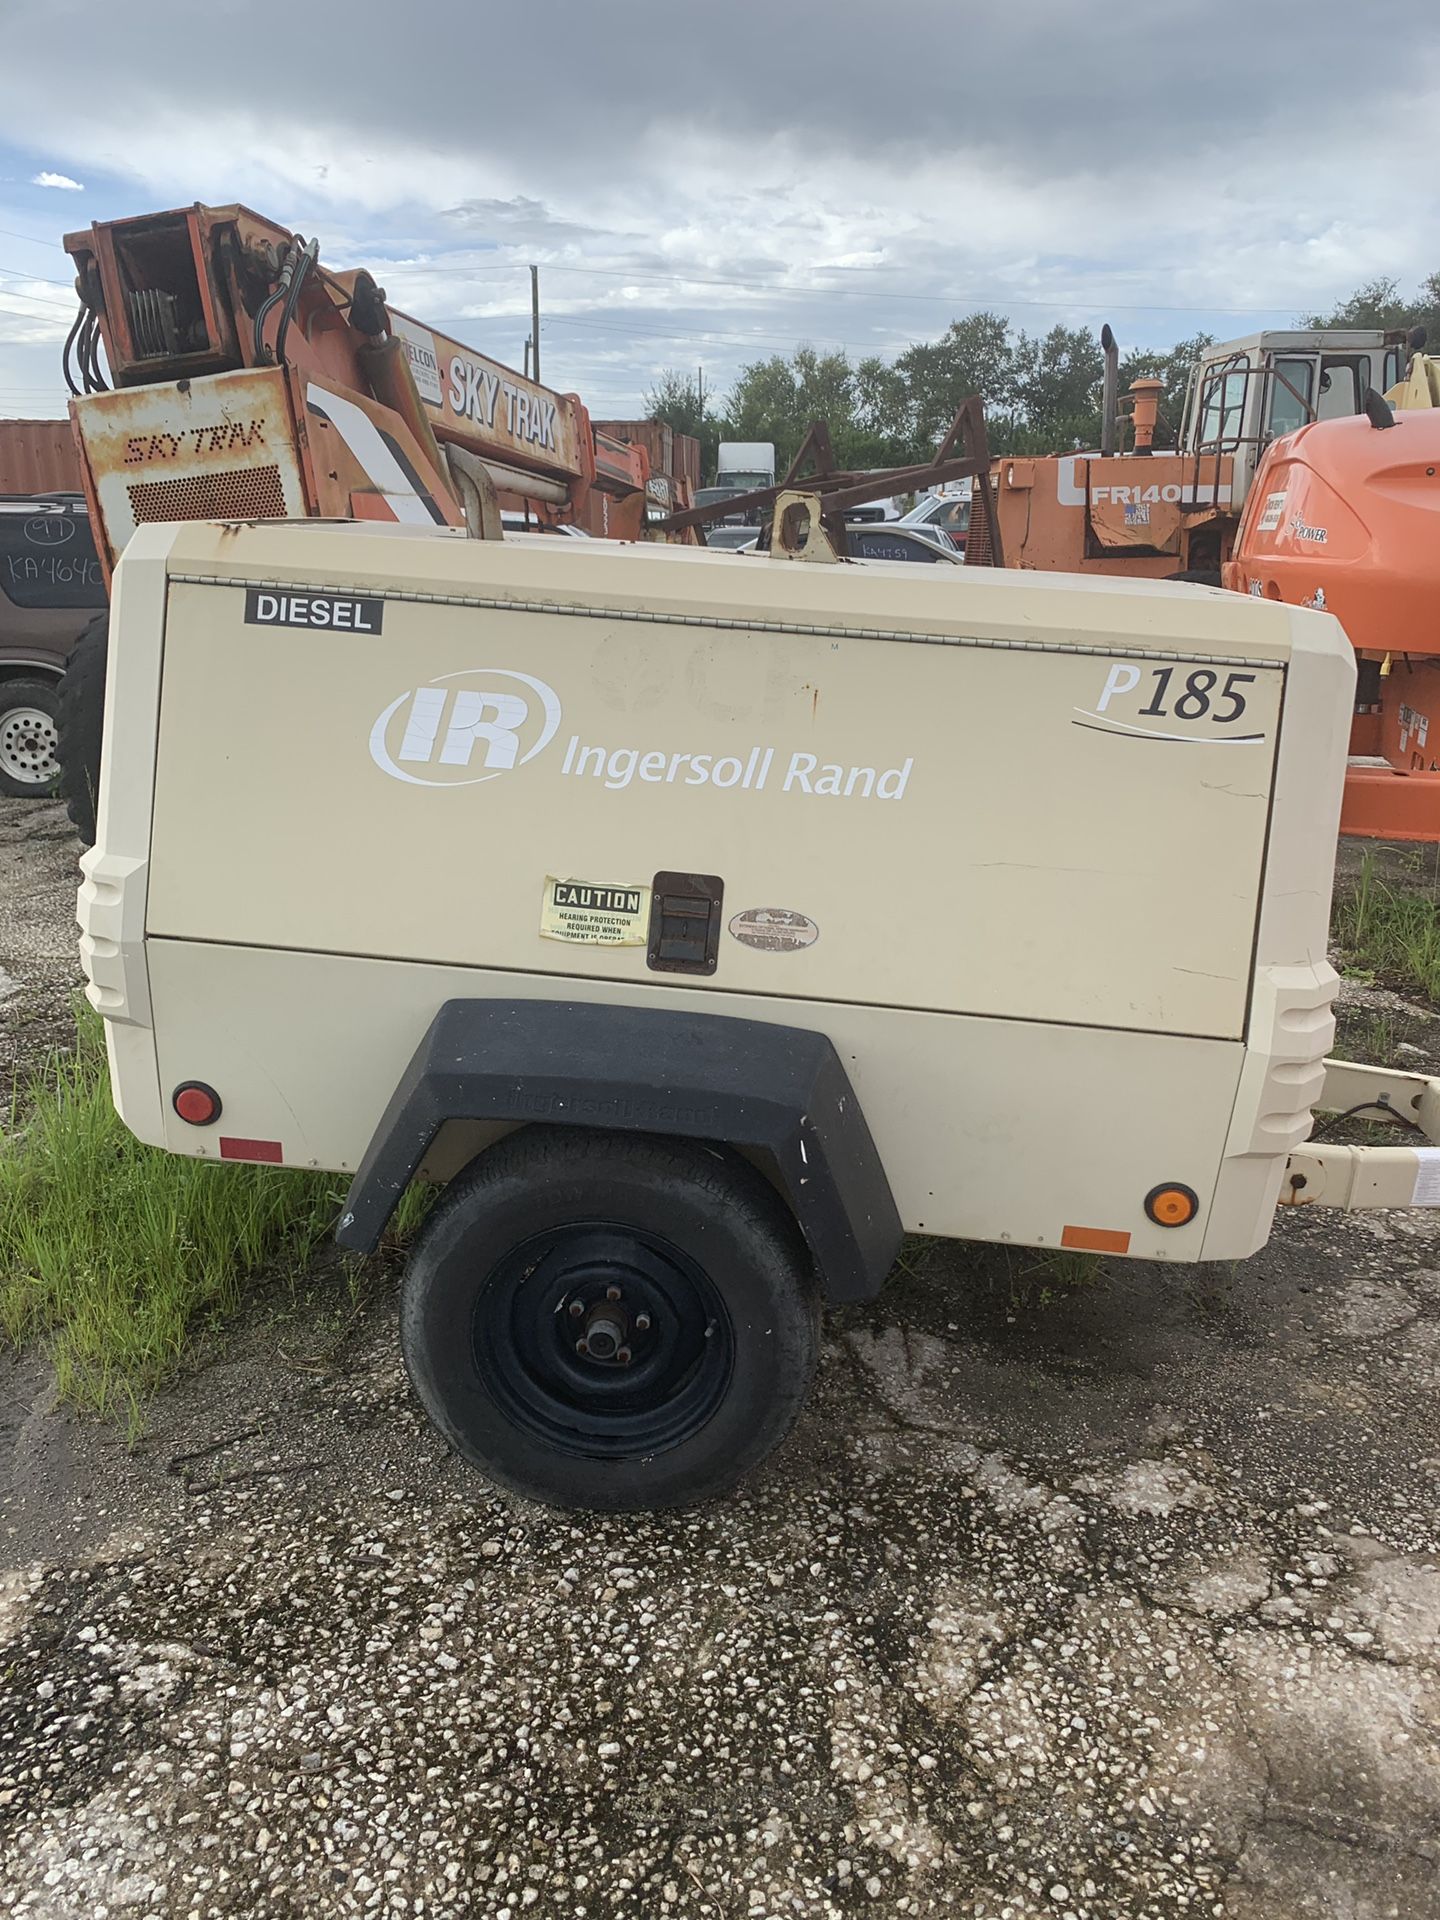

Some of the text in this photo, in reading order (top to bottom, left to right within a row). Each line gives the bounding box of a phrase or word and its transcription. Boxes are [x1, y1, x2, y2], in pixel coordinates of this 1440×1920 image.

[449, 355, 556, 452] SKY TRAK
[124, 419, 265, 463] SKY TRAK
[1092, 485, 1181, 505] FR140
[257, 594, 372, 629] DIESEL
[399, 687, 528, 770] IR
[561, 735, 914, 801] Ingersoll Rand
[555, 886, 639, 911] CAUTION
[559, 912, 631, 926] HEARING PROTECTION
[567, 922, 622, 934] REQUIRED WHEN
